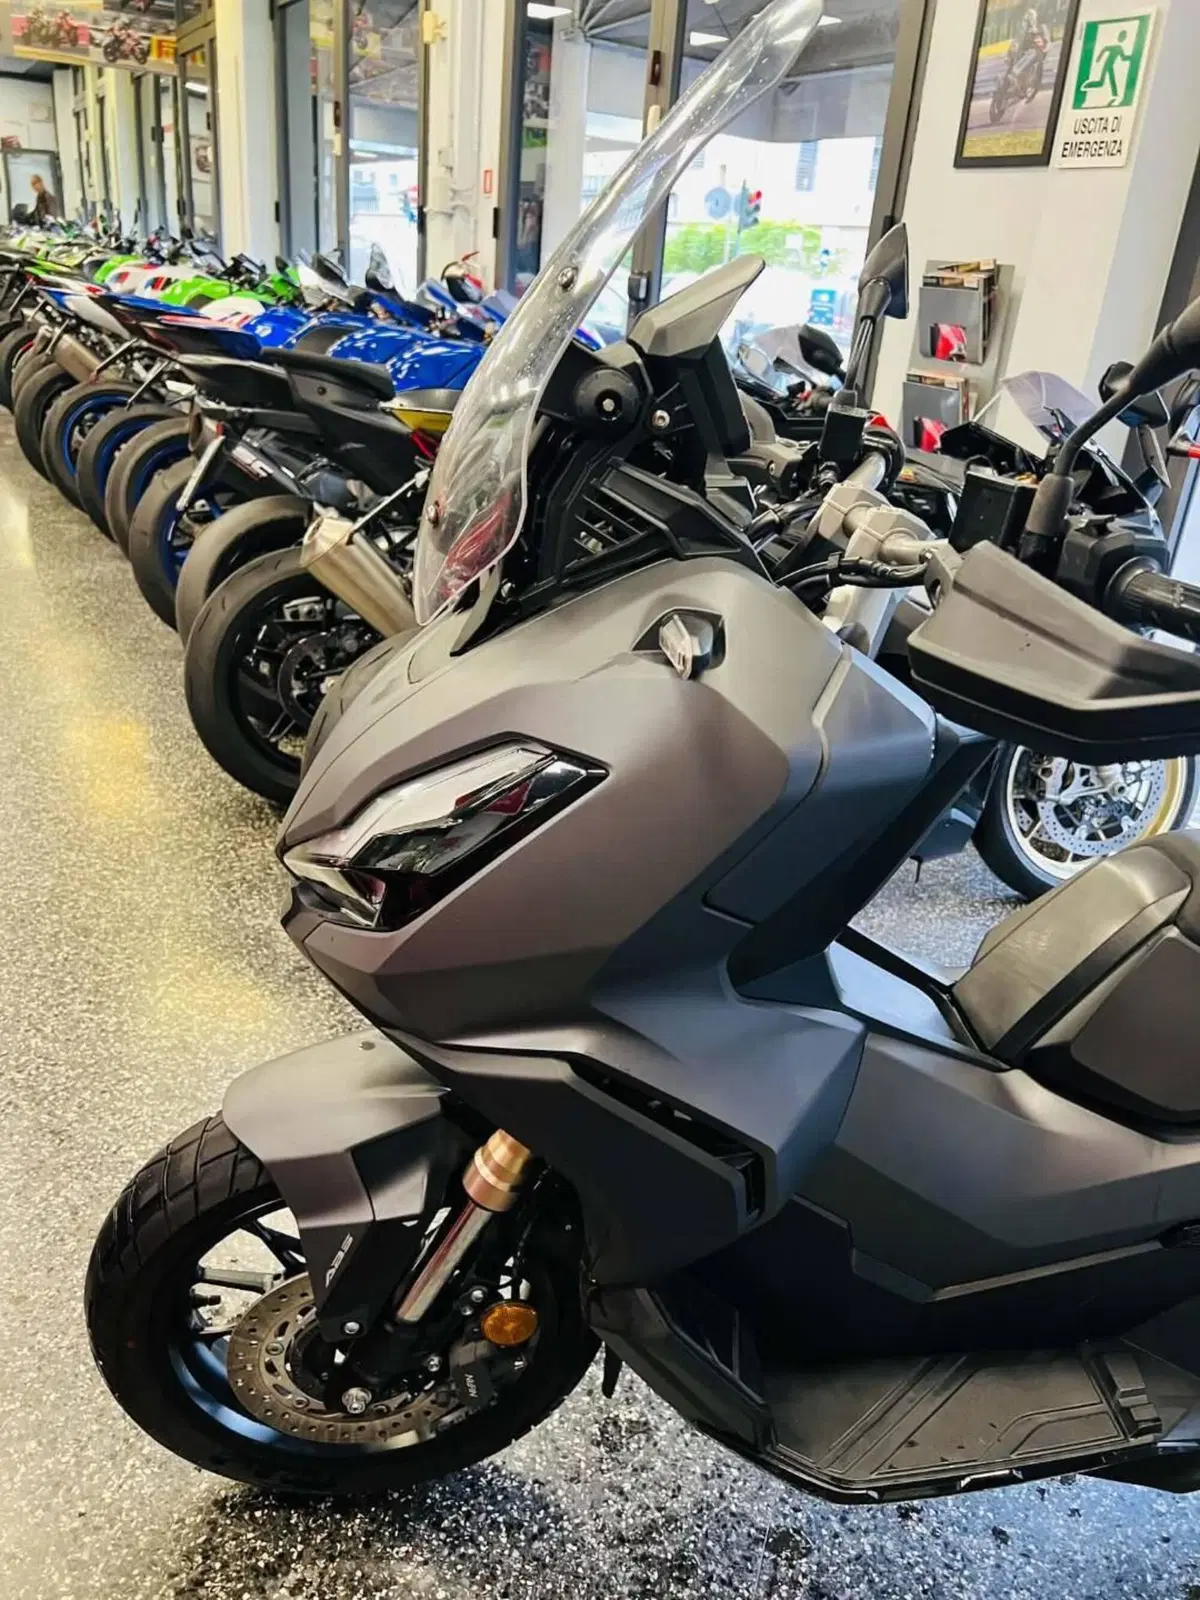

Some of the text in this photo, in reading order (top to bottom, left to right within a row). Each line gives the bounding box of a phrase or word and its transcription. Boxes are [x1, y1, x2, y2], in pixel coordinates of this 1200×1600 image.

[1073, 114, 1122, 134] USCITA DI
[1061, 140, 1122, 158] EMERGENZA
[325, 1232, 353, 1288] ABS
